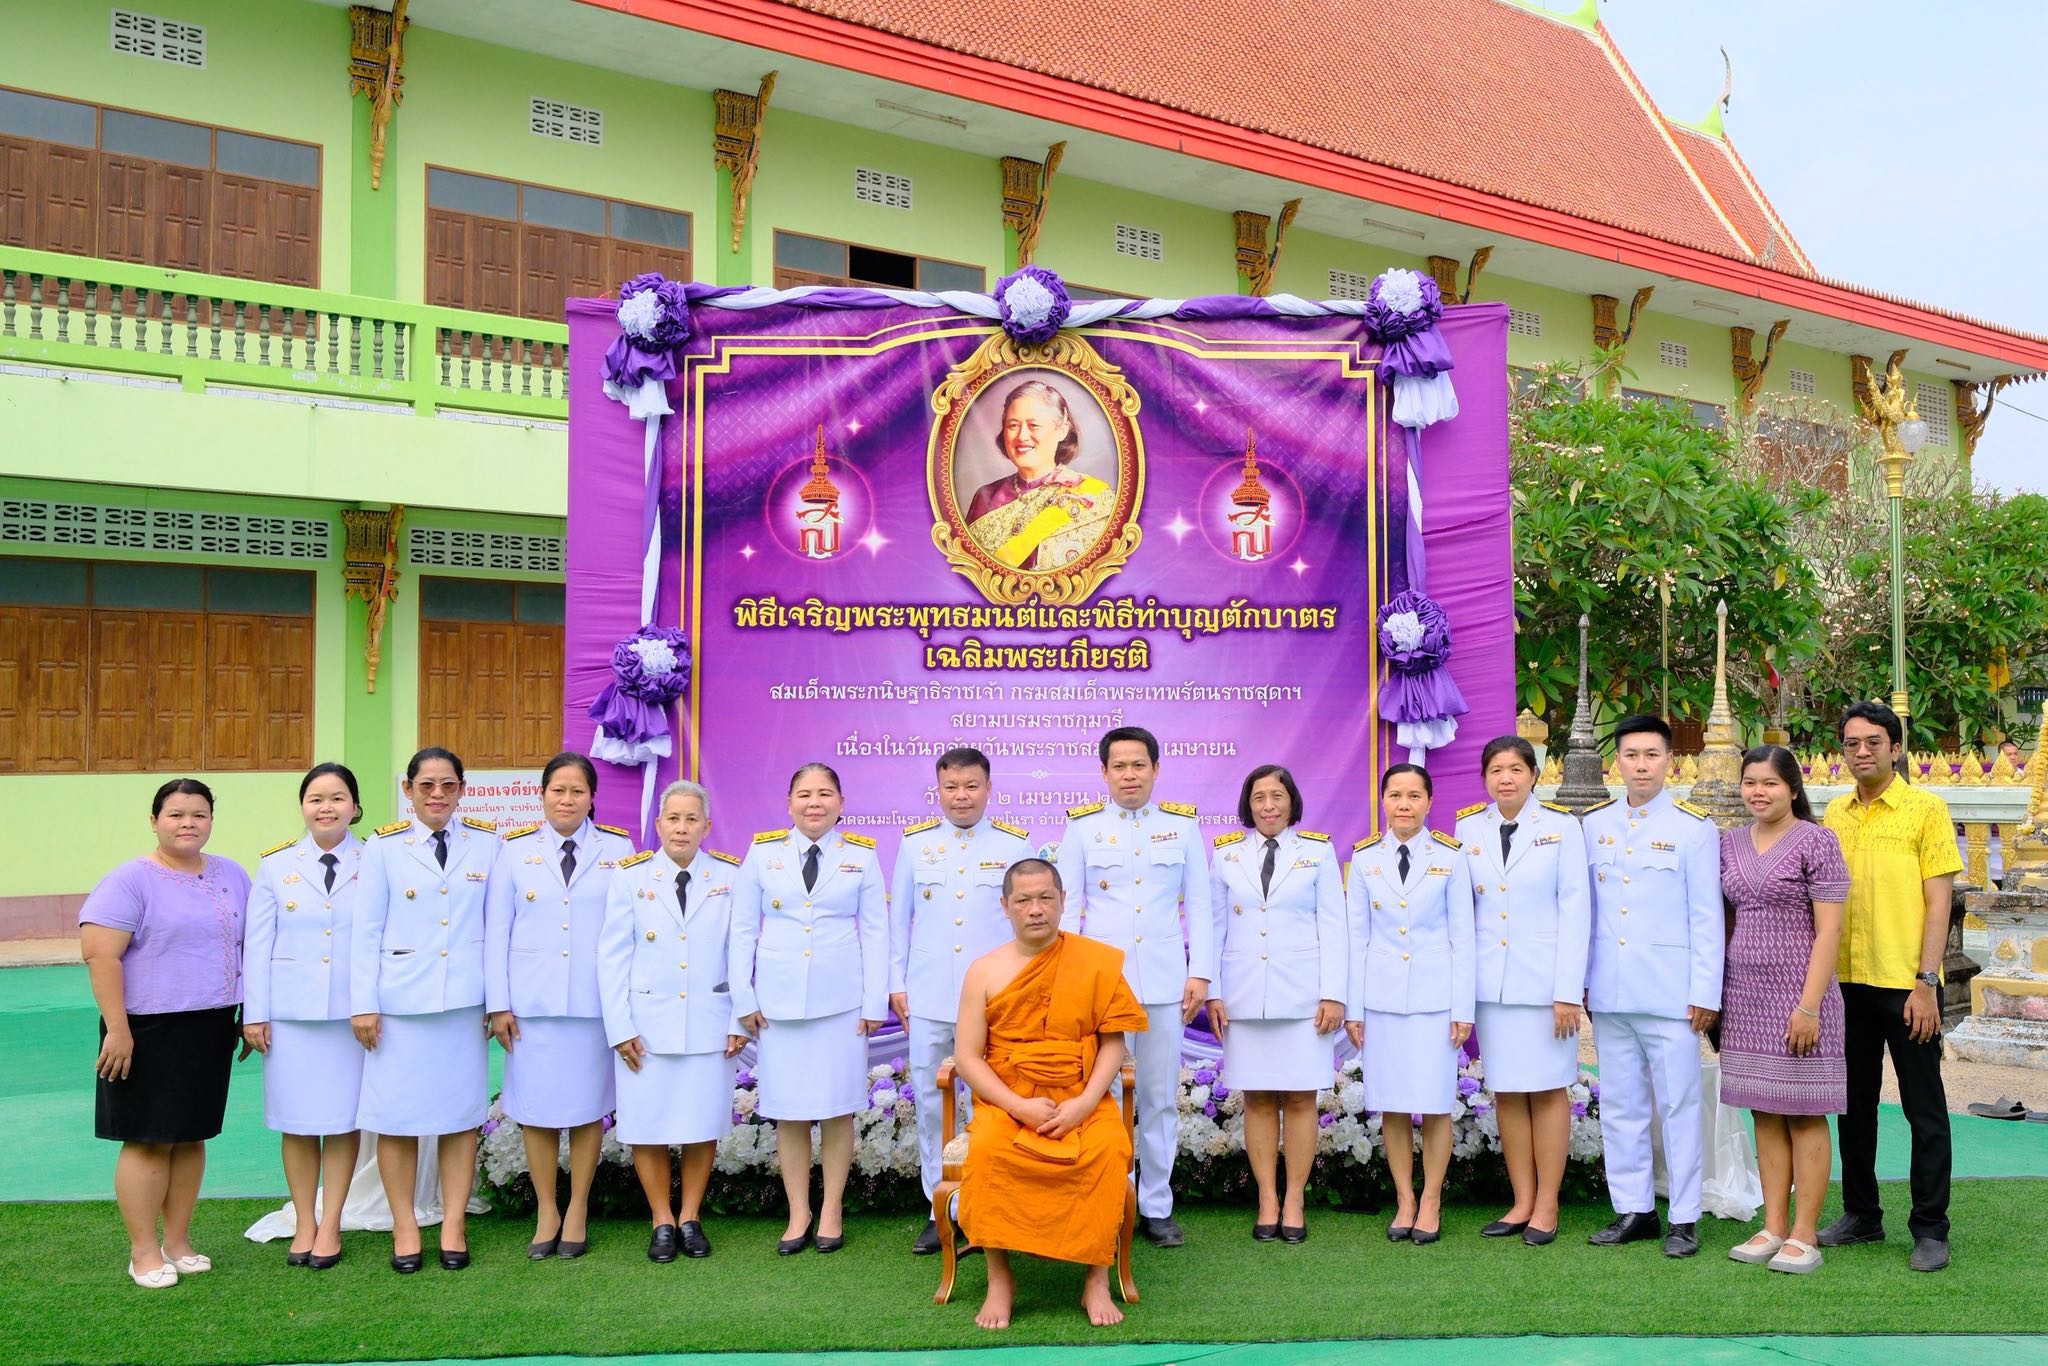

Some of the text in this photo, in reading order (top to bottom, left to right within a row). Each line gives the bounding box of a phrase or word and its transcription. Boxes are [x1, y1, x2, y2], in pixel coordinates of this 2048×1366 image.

[734, 596, 1337, 640] พิธีเจริญพระพุทธมนต์และพิธีทำบุญตักบาตร
[926, 638, 1149, 670] เฉลิมพระเกียรติ
[769, 676, 1302, 707] สมเด็จพระกนิษฐาธิราชเจ้า กรมสมเด็จพระเทพรัตนราชสุดาฯ
[950, 708, 1124, 735] สยามบรมราชกุมารี
[1163, 740, 1237, 756] เมษายน
[1019, 790, 1091, 805] เมษายน
